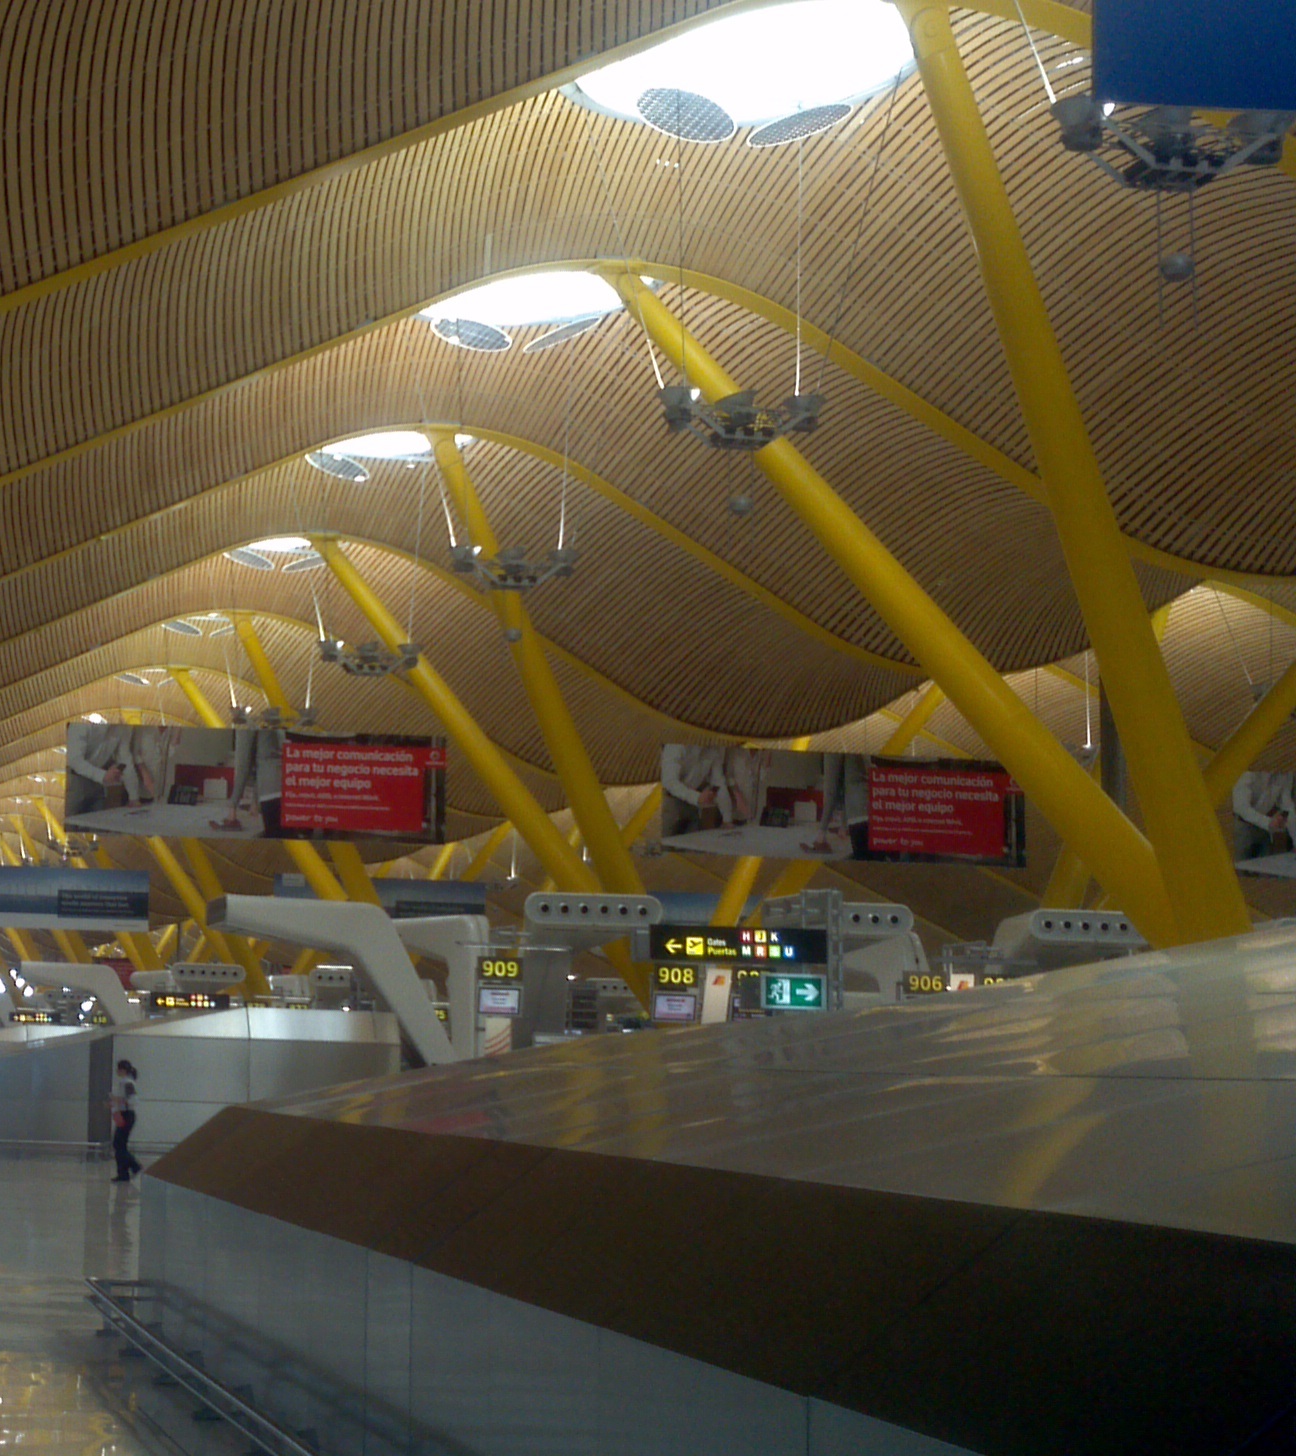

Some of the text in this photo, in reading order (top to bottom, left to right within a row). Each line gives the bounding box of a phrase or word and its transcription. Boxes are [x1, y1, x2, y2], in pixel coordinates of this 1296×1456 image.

[286, 747, 413, 762] La mejor comunicación
[286, 762, 419, 776] para tu negocio necesita
[285, 775, 371, 790] el mejor equipo
[872, 770, 993, 787] La mejor comunicación
[872, 787, 999, 802] para tu negocio necesita
[872, 799, 954, 814] el mejor equipo
[707, 938, 726, 946] Gates
[743, 931, 751, 941] H
[770, 932, 779, 942] K
[708, 947, 737, 956] Puertas
[742, 946, 751, 956] M
[756, 946, 764, 957] R
[784, 946, 794, 957] U
[482, 960, 518, 977] 909
[659, 967, 694, 984] 908
[909, 975, 942, 991] 906
